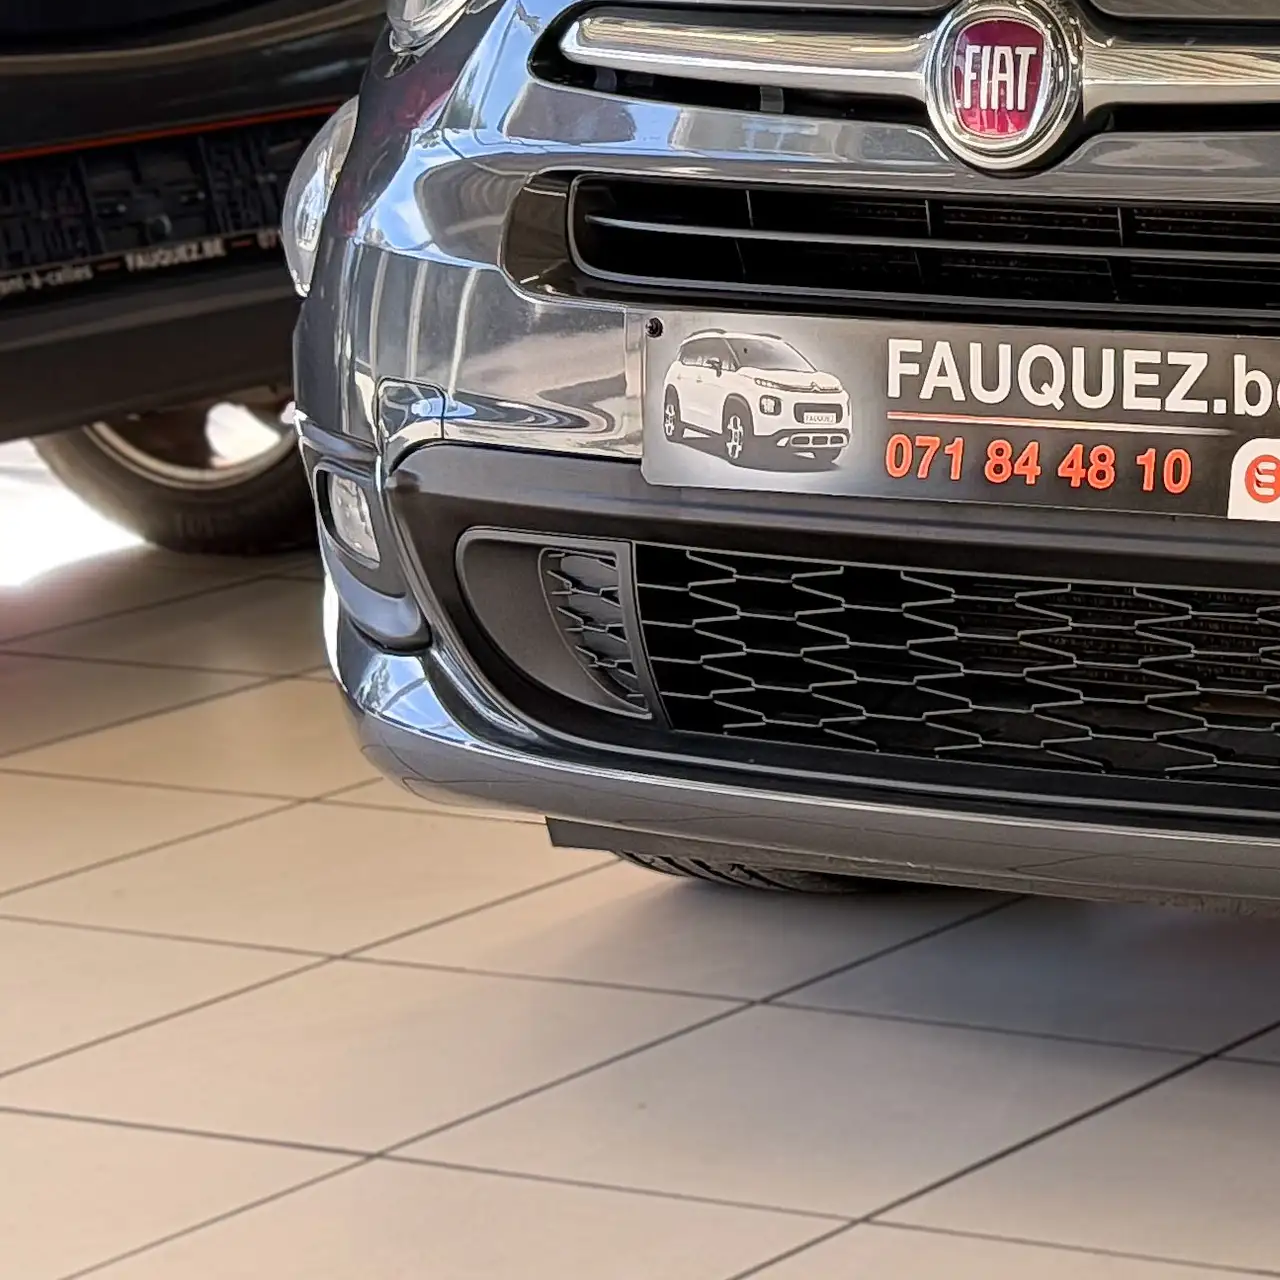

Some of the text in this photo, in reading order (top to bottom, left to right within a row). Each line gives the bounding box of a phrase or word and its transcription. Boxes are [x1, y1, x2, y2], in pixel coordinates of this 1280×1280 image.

[963, 45, 1037, 111] FIAT
[885, 433, 1193, 494] 071 84 48 10
